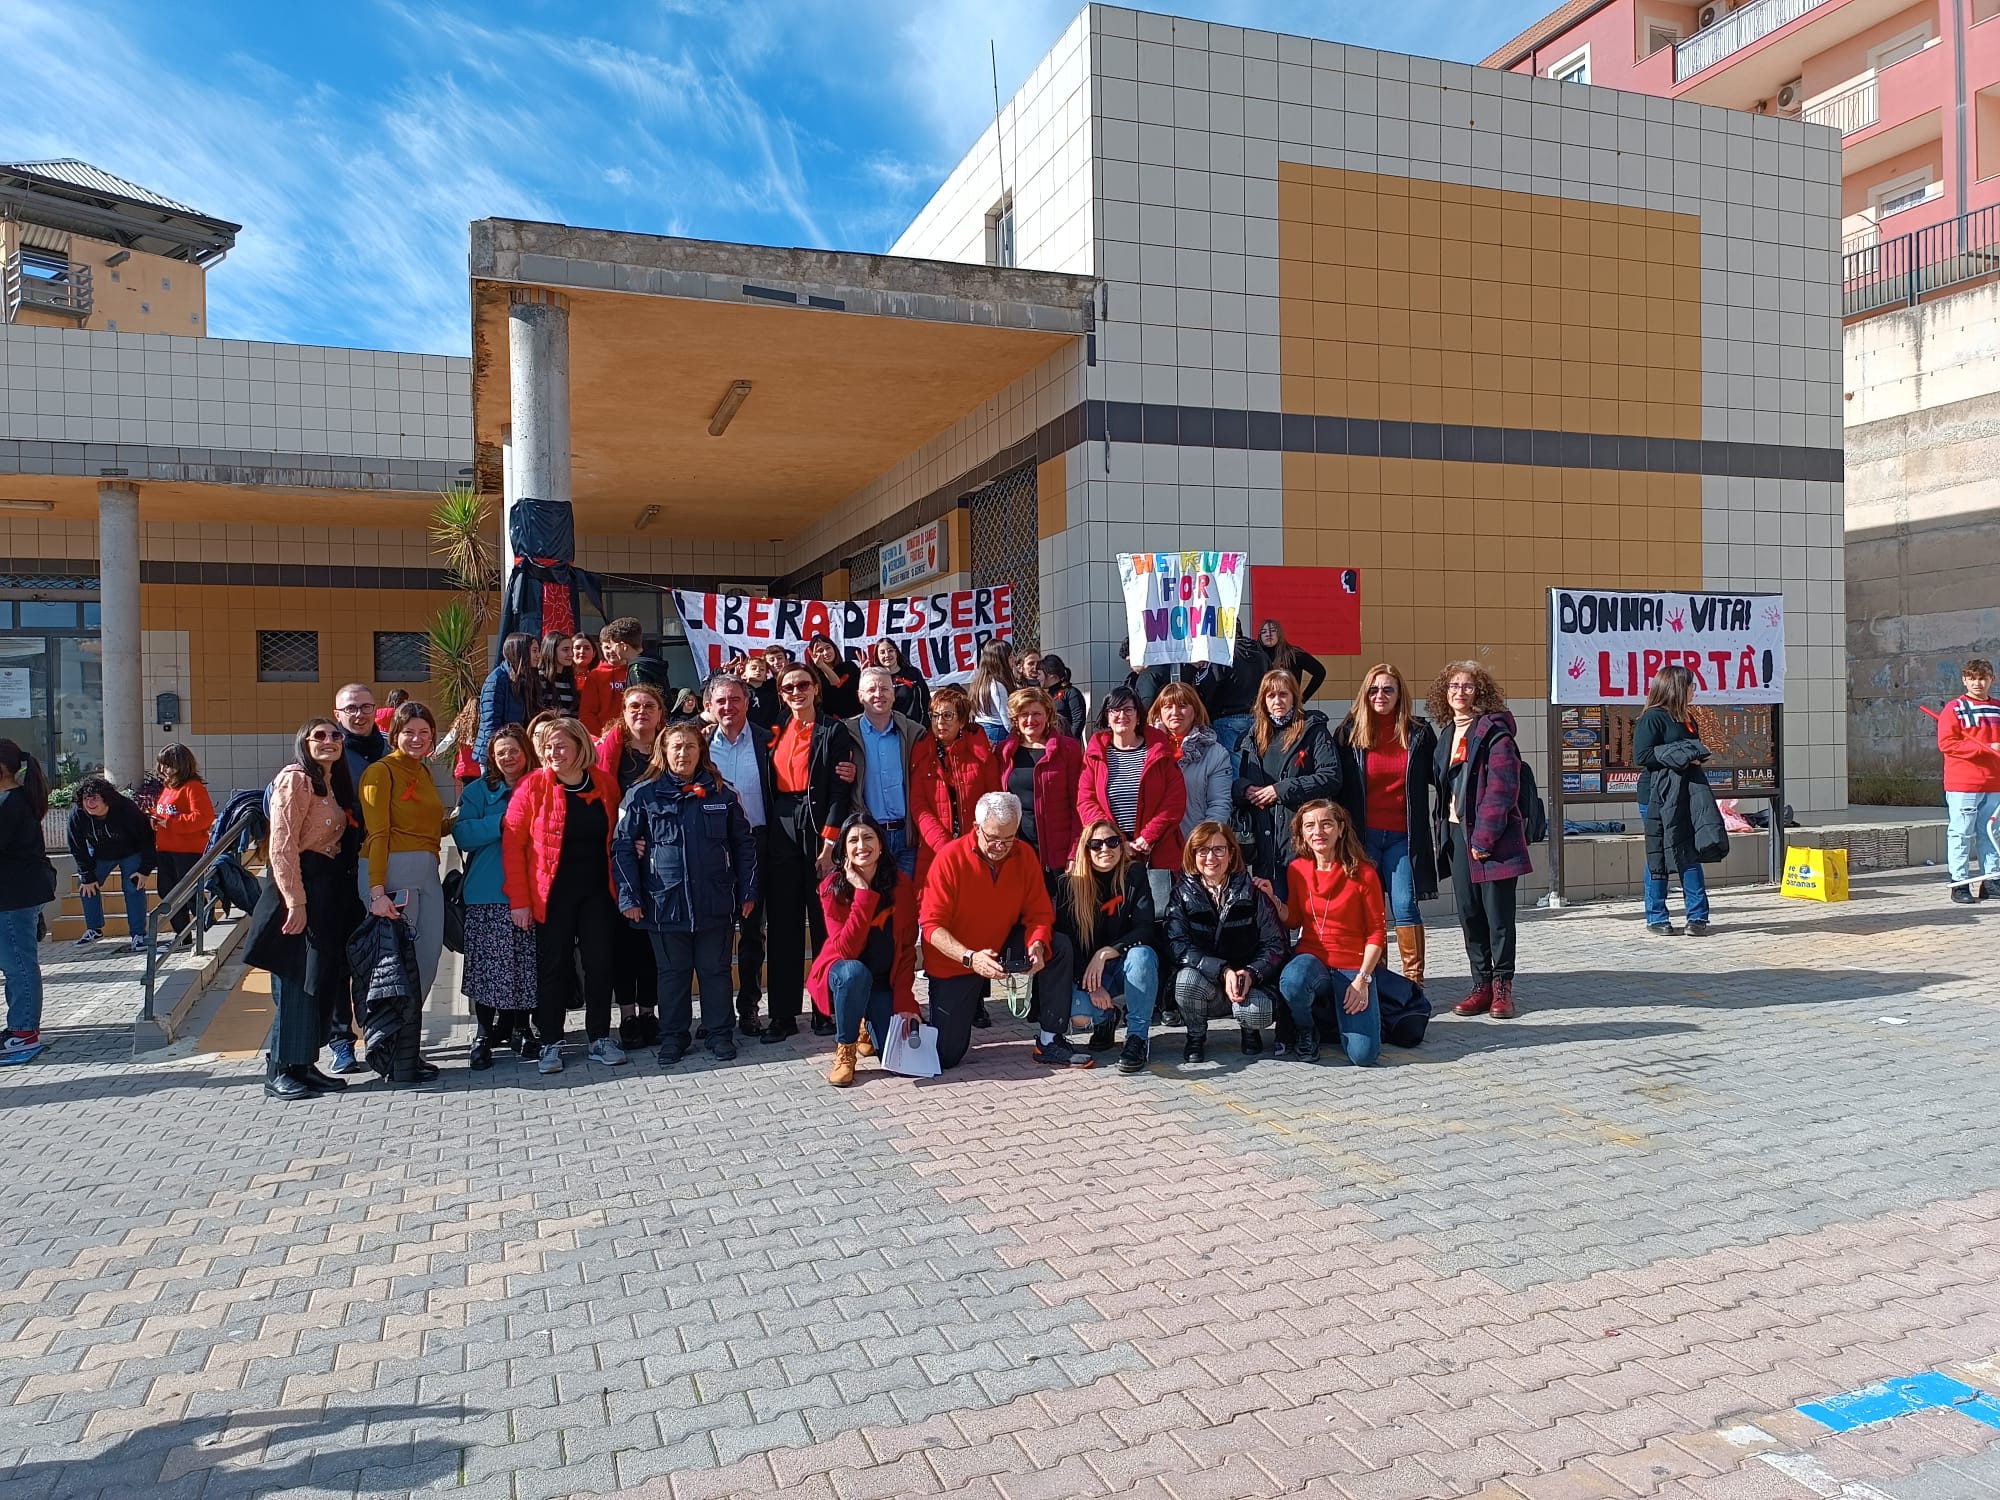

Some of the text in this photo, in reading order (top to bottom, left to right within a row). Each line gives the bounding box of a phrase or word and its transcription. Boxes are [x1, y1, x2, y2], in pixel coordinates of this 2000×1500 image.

[1132, 553, 1169, 575] WE
[1163, 575, 1210, 601] FOR
[675, 591, 831, 641] LIBERA
[1143, 605, 1236, 642] WOMAN
[1560, 593, 1752, 634] DONNA! VITA!
[1737, 769, 1775, 779] S.I.T.A.B.
